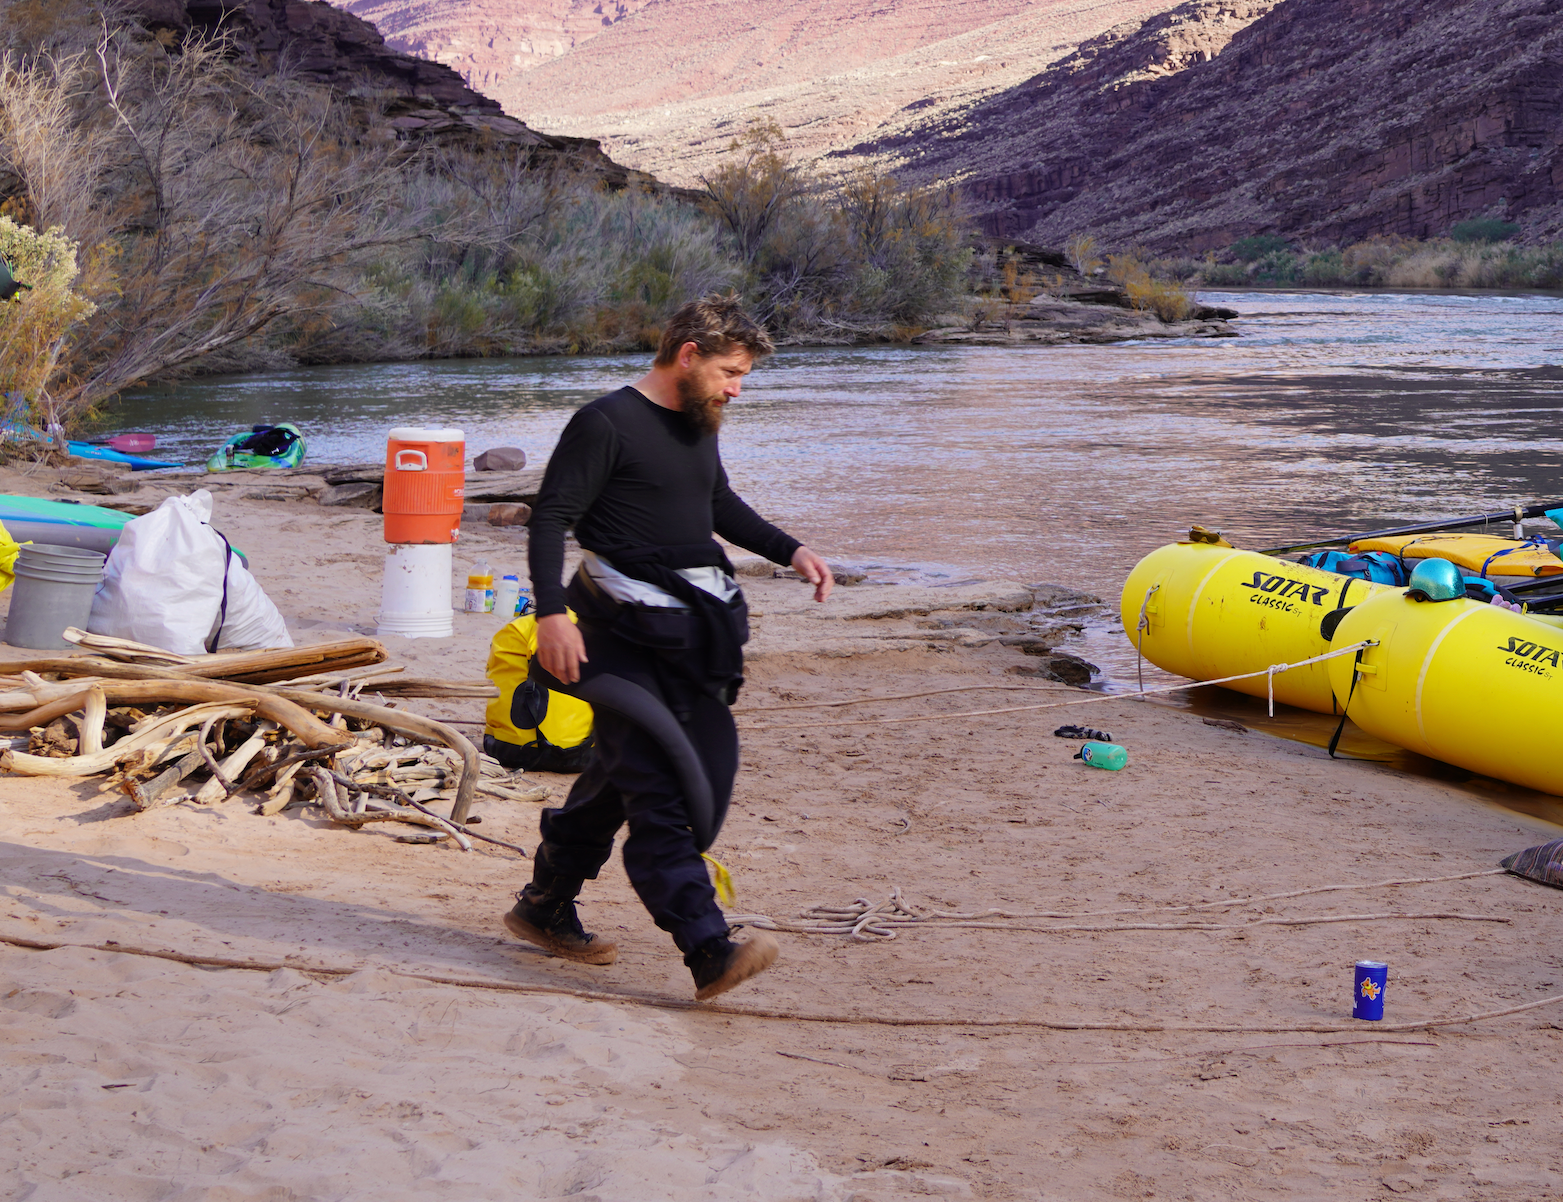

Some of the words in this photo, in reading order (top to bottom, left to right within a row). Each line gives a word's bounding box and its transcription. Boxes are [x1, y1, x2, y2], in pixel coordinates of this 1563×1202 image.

[1241, 571, 1330, 606] SOTAR
[1250, 594, 1294, 612] CLASSIC
[1505, 657, 1546, 676] CLASSIC
